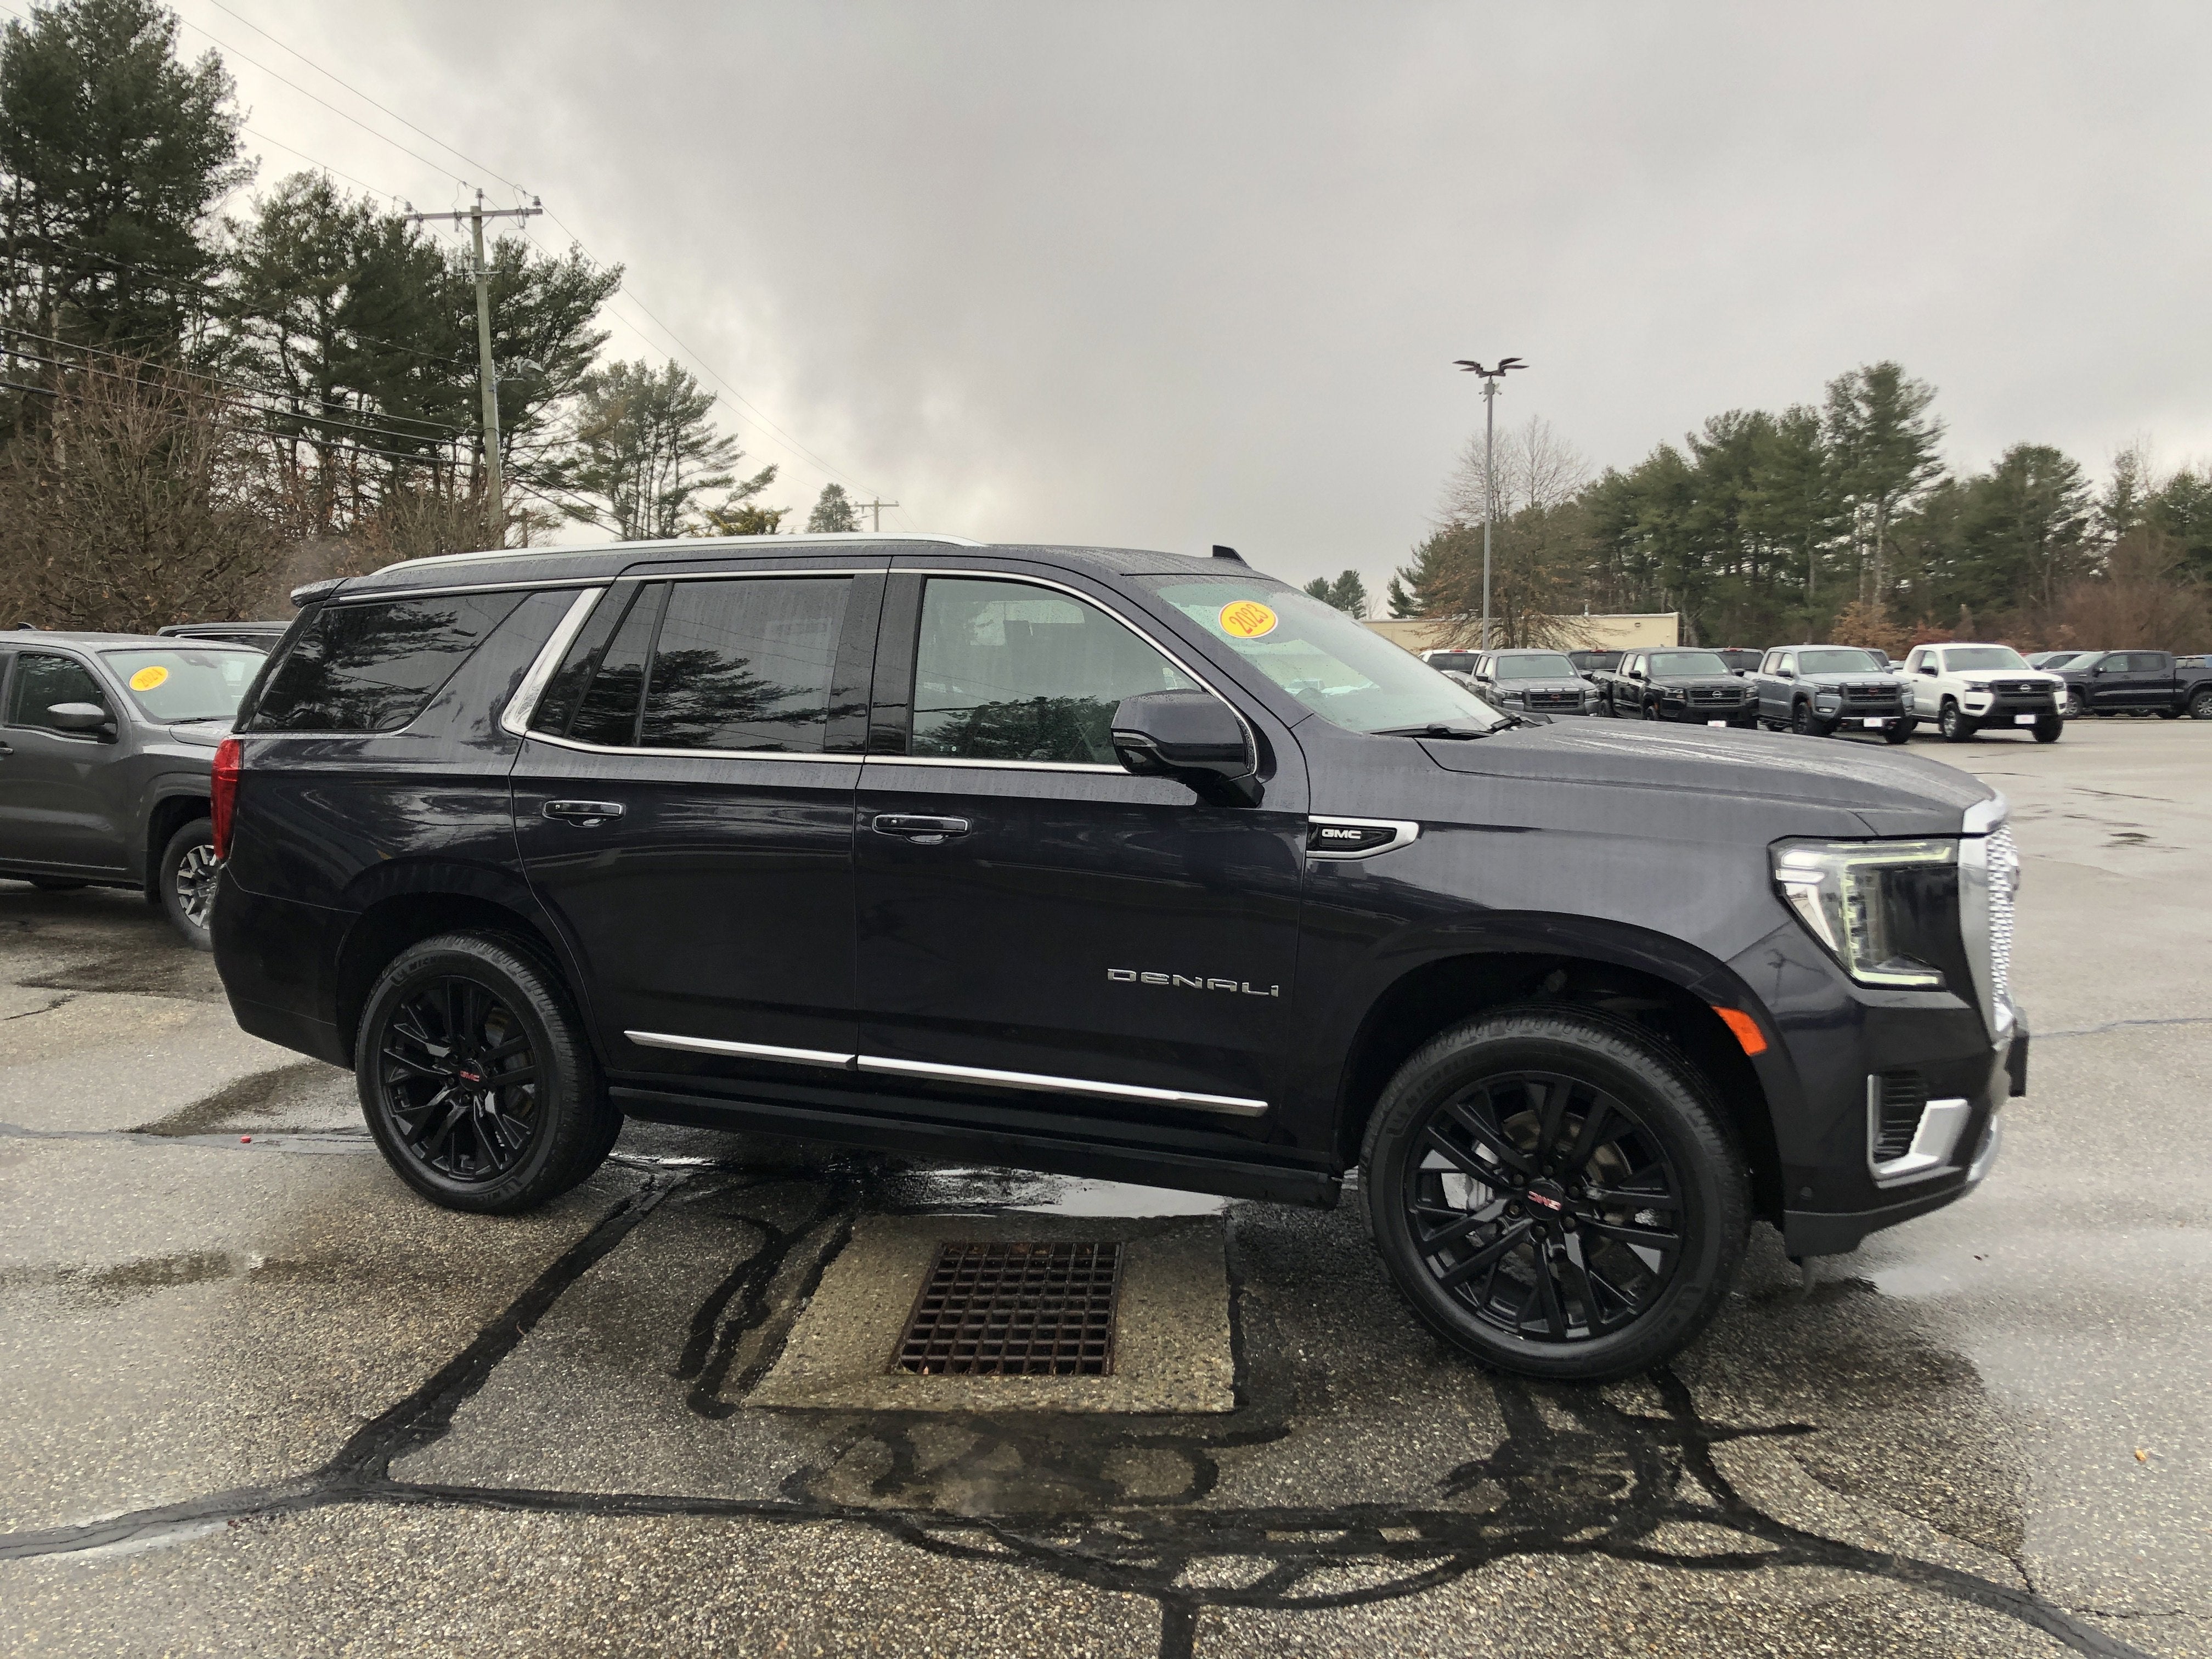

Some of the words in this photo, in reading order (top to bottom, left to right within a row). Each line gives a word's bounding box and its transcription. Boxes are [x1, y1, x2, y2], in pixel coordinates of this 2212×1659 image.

[1229, 603, 1268, 634] 2023
[136, 668, 163, 688] 2024
[1322, 828, 1362, 840] GMC
[1107, 968, 1279, 997] DENALI
[460, 1070, 480, 1082] GMC
[1527, 1190, 1562, 1211] GMC
